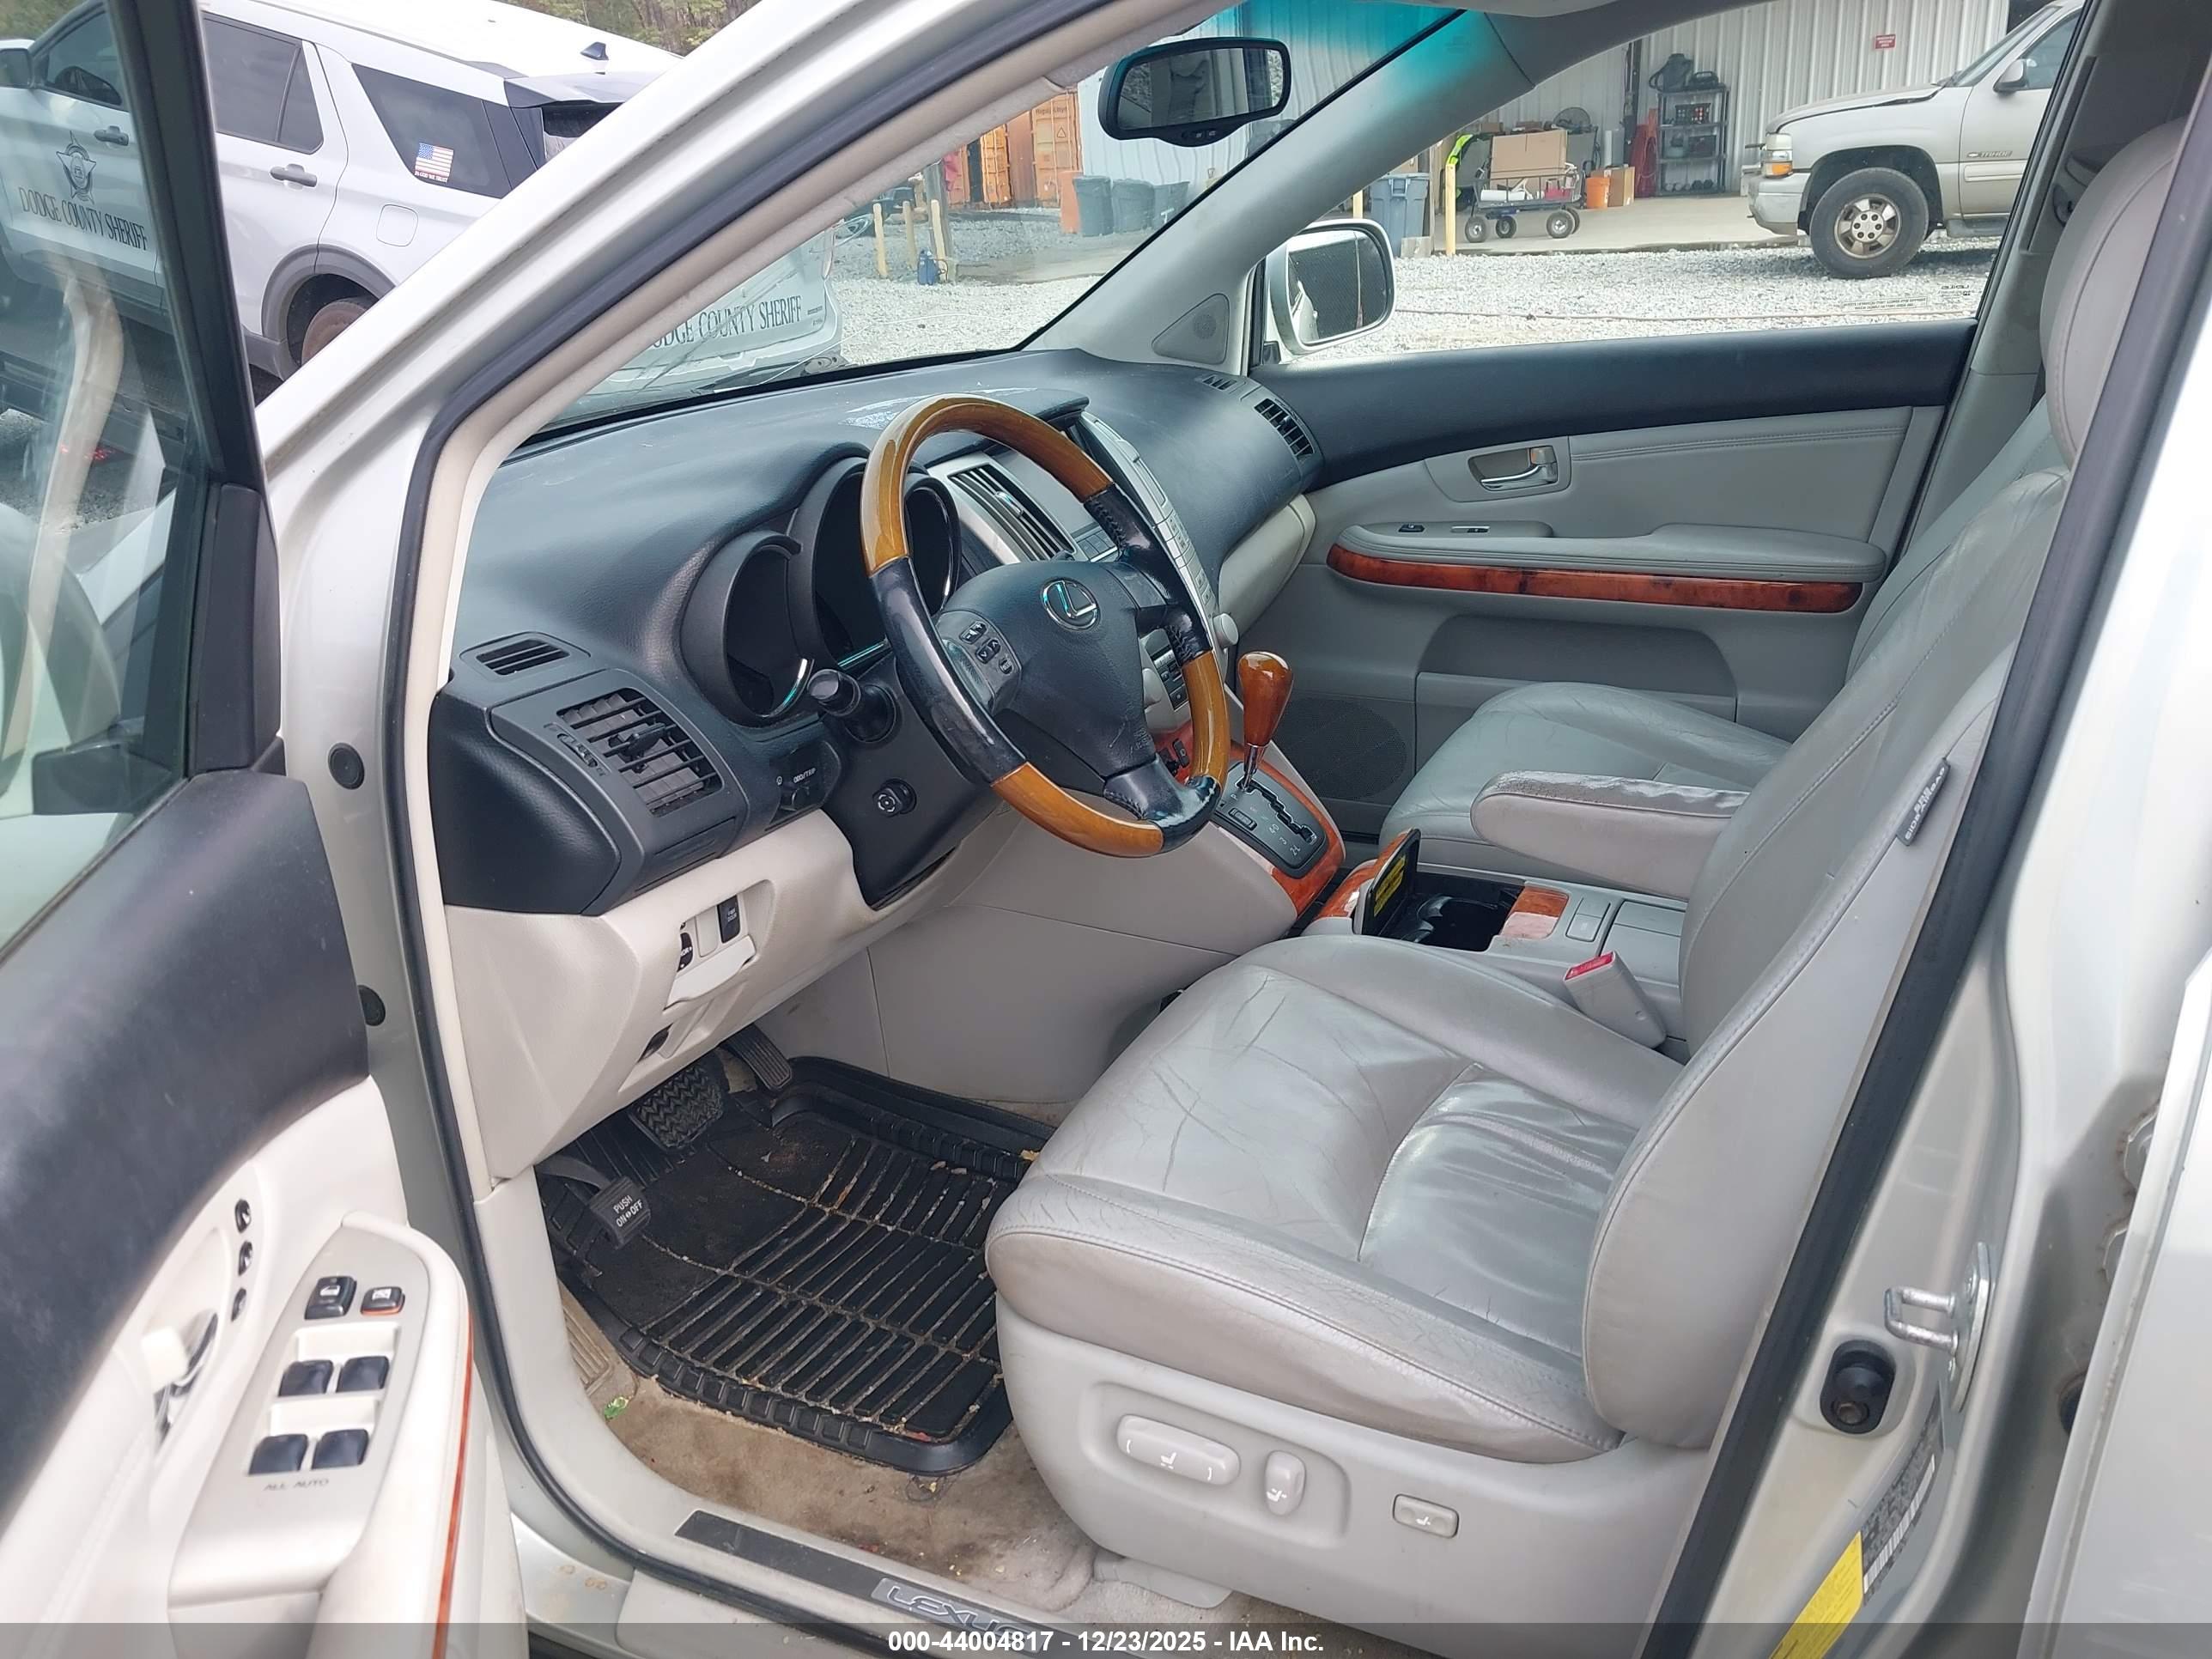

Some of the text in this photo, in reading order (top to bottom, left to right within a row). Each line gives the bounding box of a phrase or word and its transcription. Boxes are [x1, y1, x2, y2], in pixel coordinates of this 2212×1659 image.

[19, 187, 149, 251] DODGE COUNTY SHERIFF
[698, 303, 755, 337] COUNTY
[758, 296, 802, 330] SHERIFF
[793, 767, 817, 783] ODO/TRIP
[1905, 767, 1946, 840] SIDE AIRBAG
[613, 1195, 633, 1213] PUSH
[293, 1478, 330, 1489] AUTO
